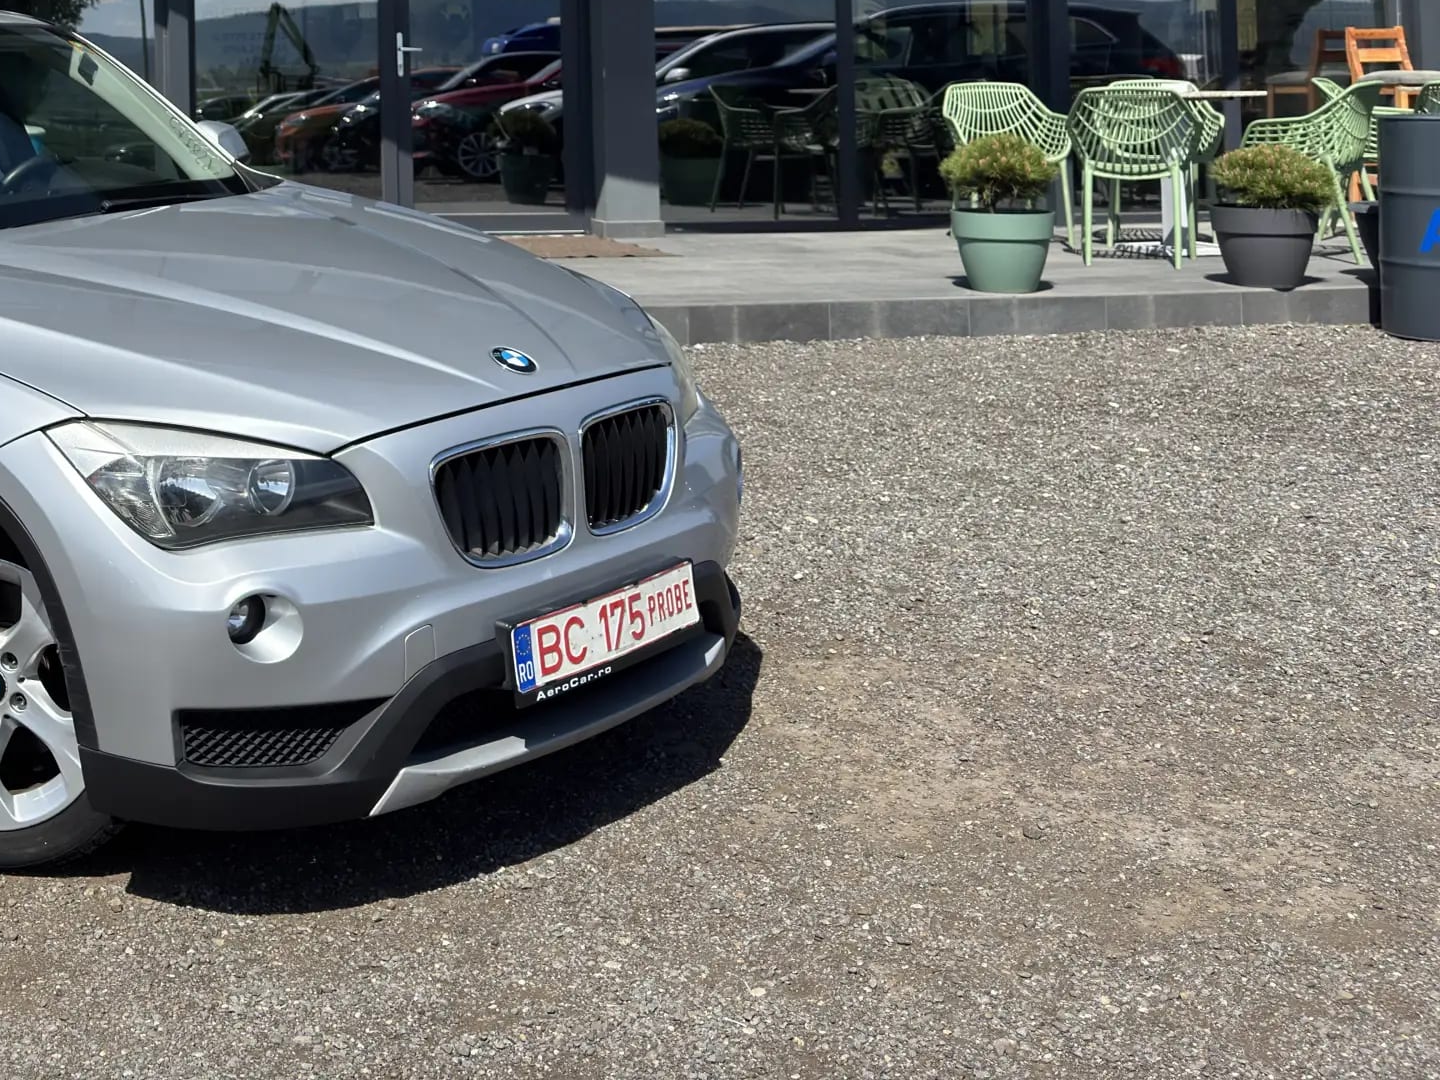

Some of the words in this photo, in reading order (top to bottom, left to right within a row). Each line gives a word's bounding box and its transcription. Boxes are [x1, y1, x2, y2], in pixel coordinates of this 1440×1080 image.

[537, 616, 588, 677] BC
[599, 593, 646, 652] 175
[647, 579, 692, 626] PROBE
[519, 661, 534, 683] RO
[537, 666, 612, 701] AeroCar.ro
